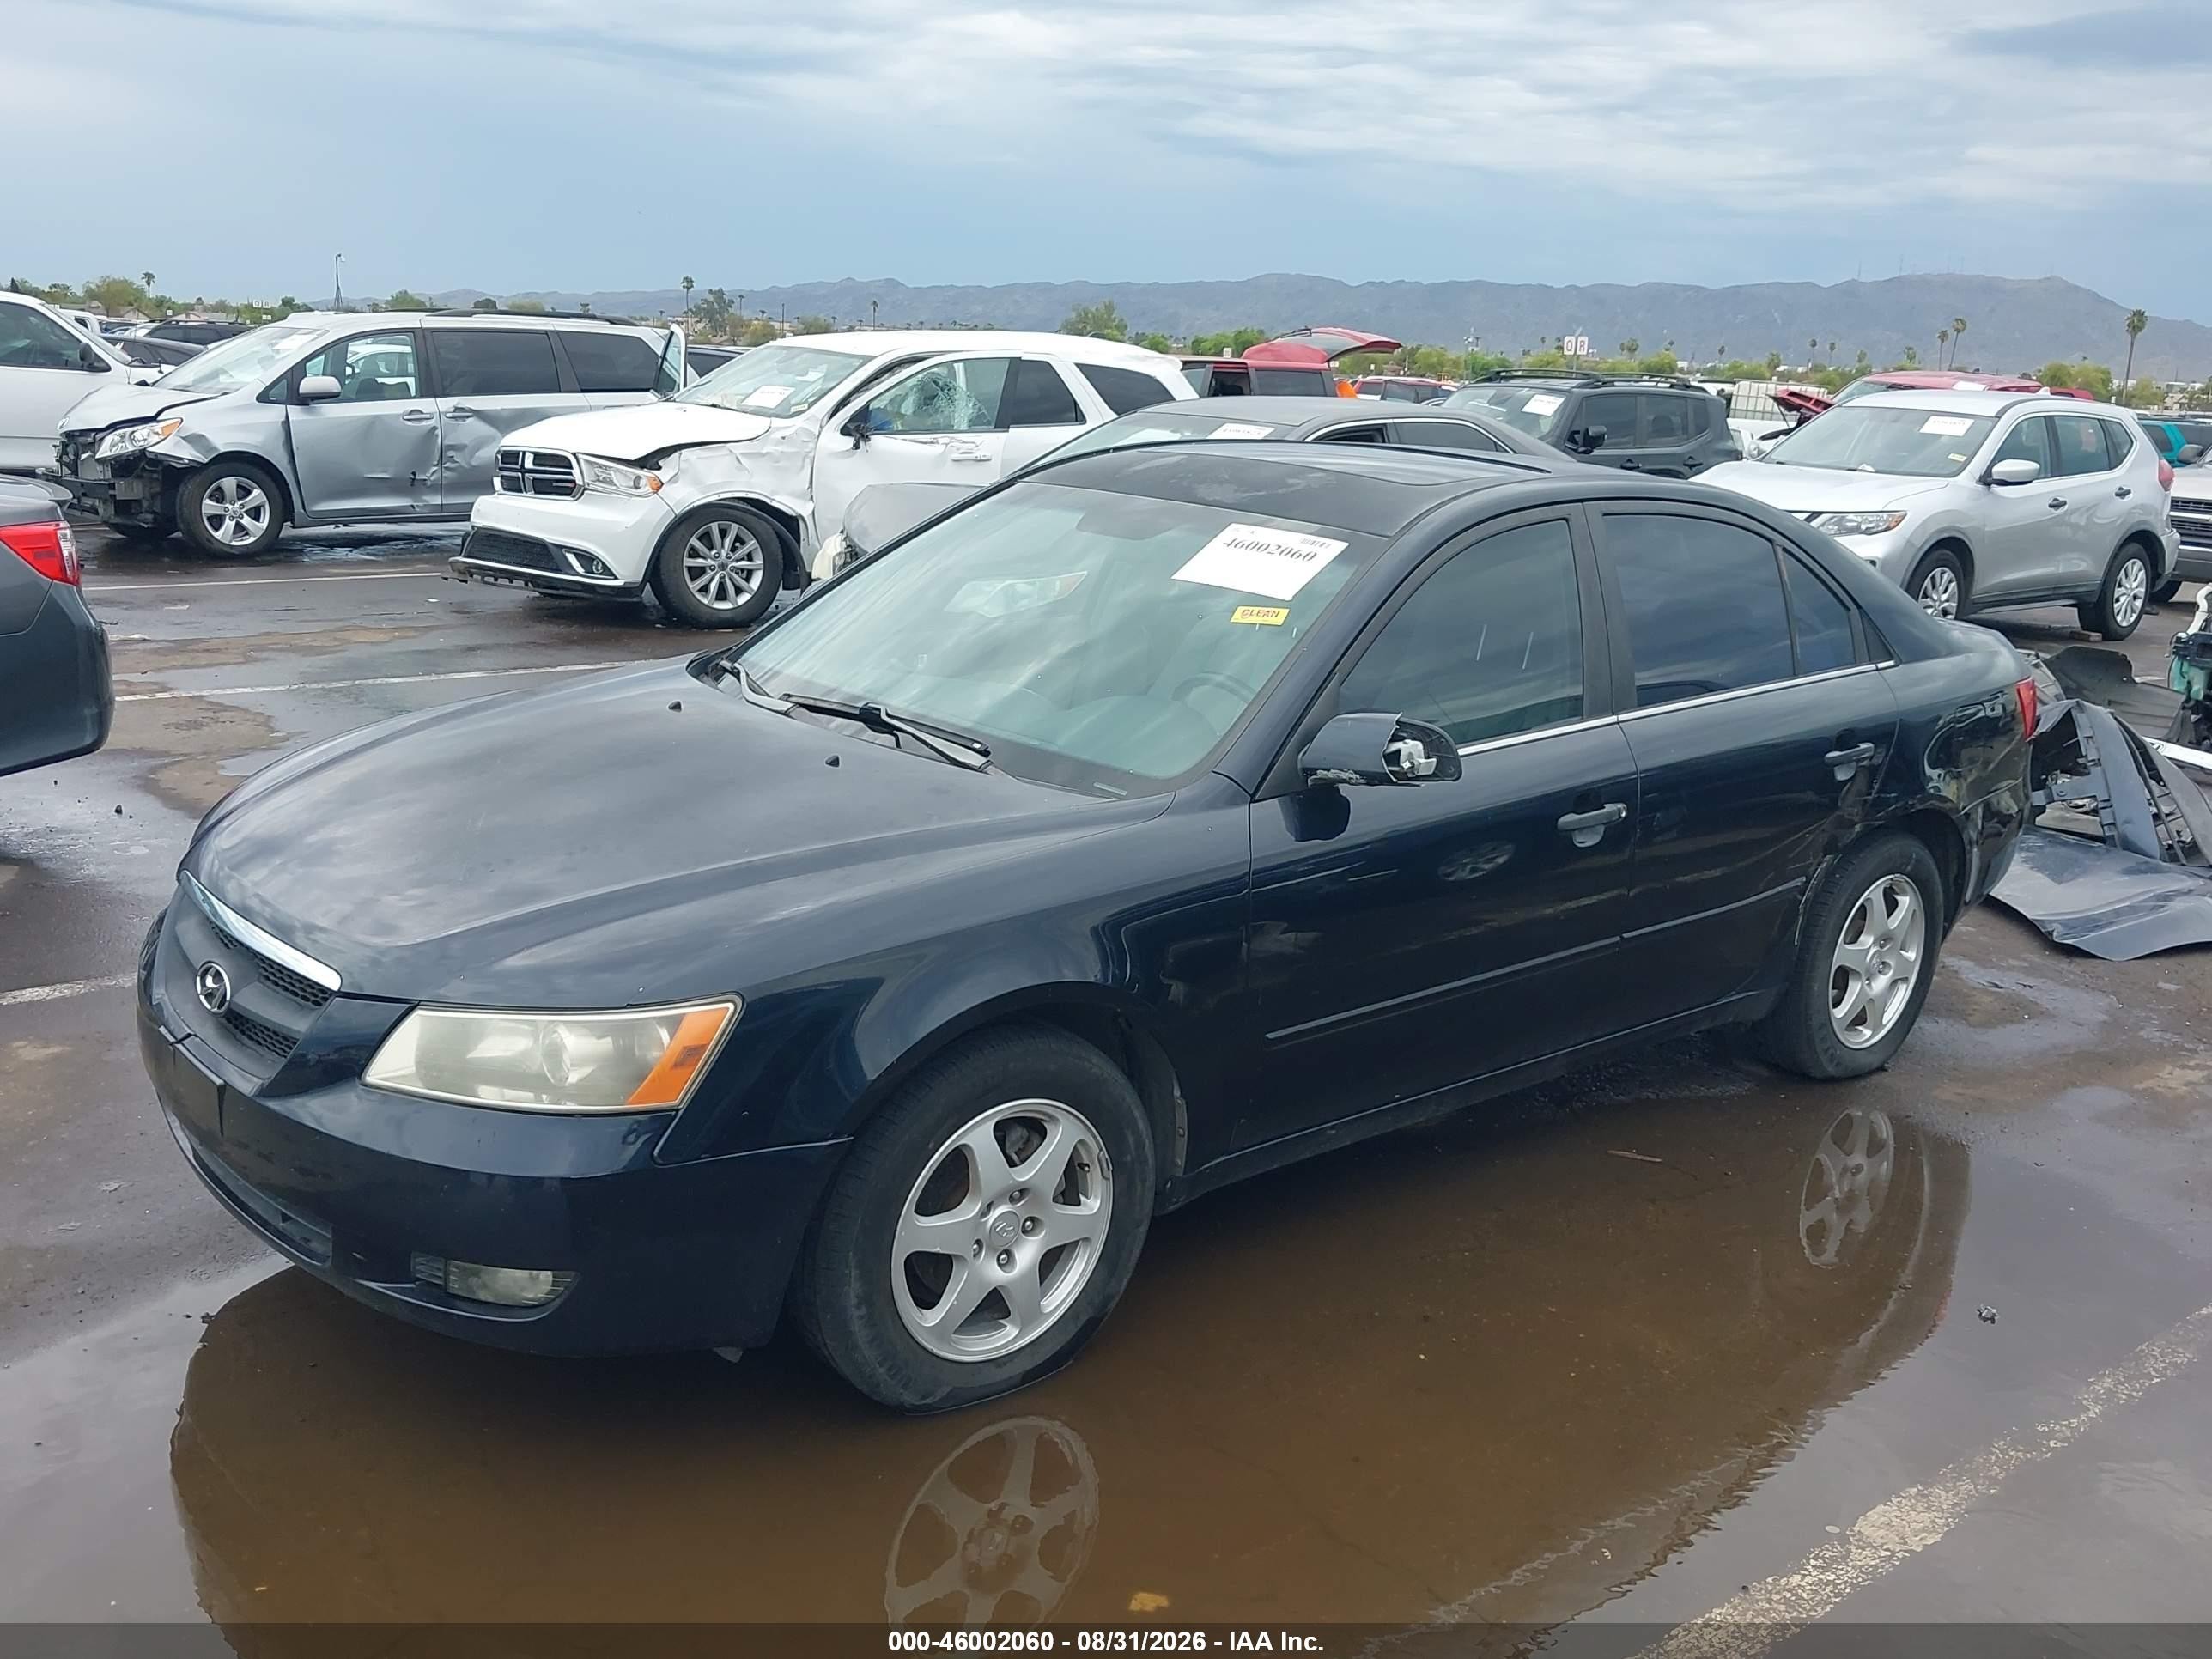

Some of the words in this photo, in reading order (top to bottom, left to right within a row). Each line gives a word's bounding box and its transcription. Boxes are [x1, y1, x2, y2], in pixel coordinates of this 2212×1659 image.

[1579, 340, 1586, 352] R
[1223, 538, 1317, 562] 46002060
[1241, 609, 1280, 618] CLEAN
